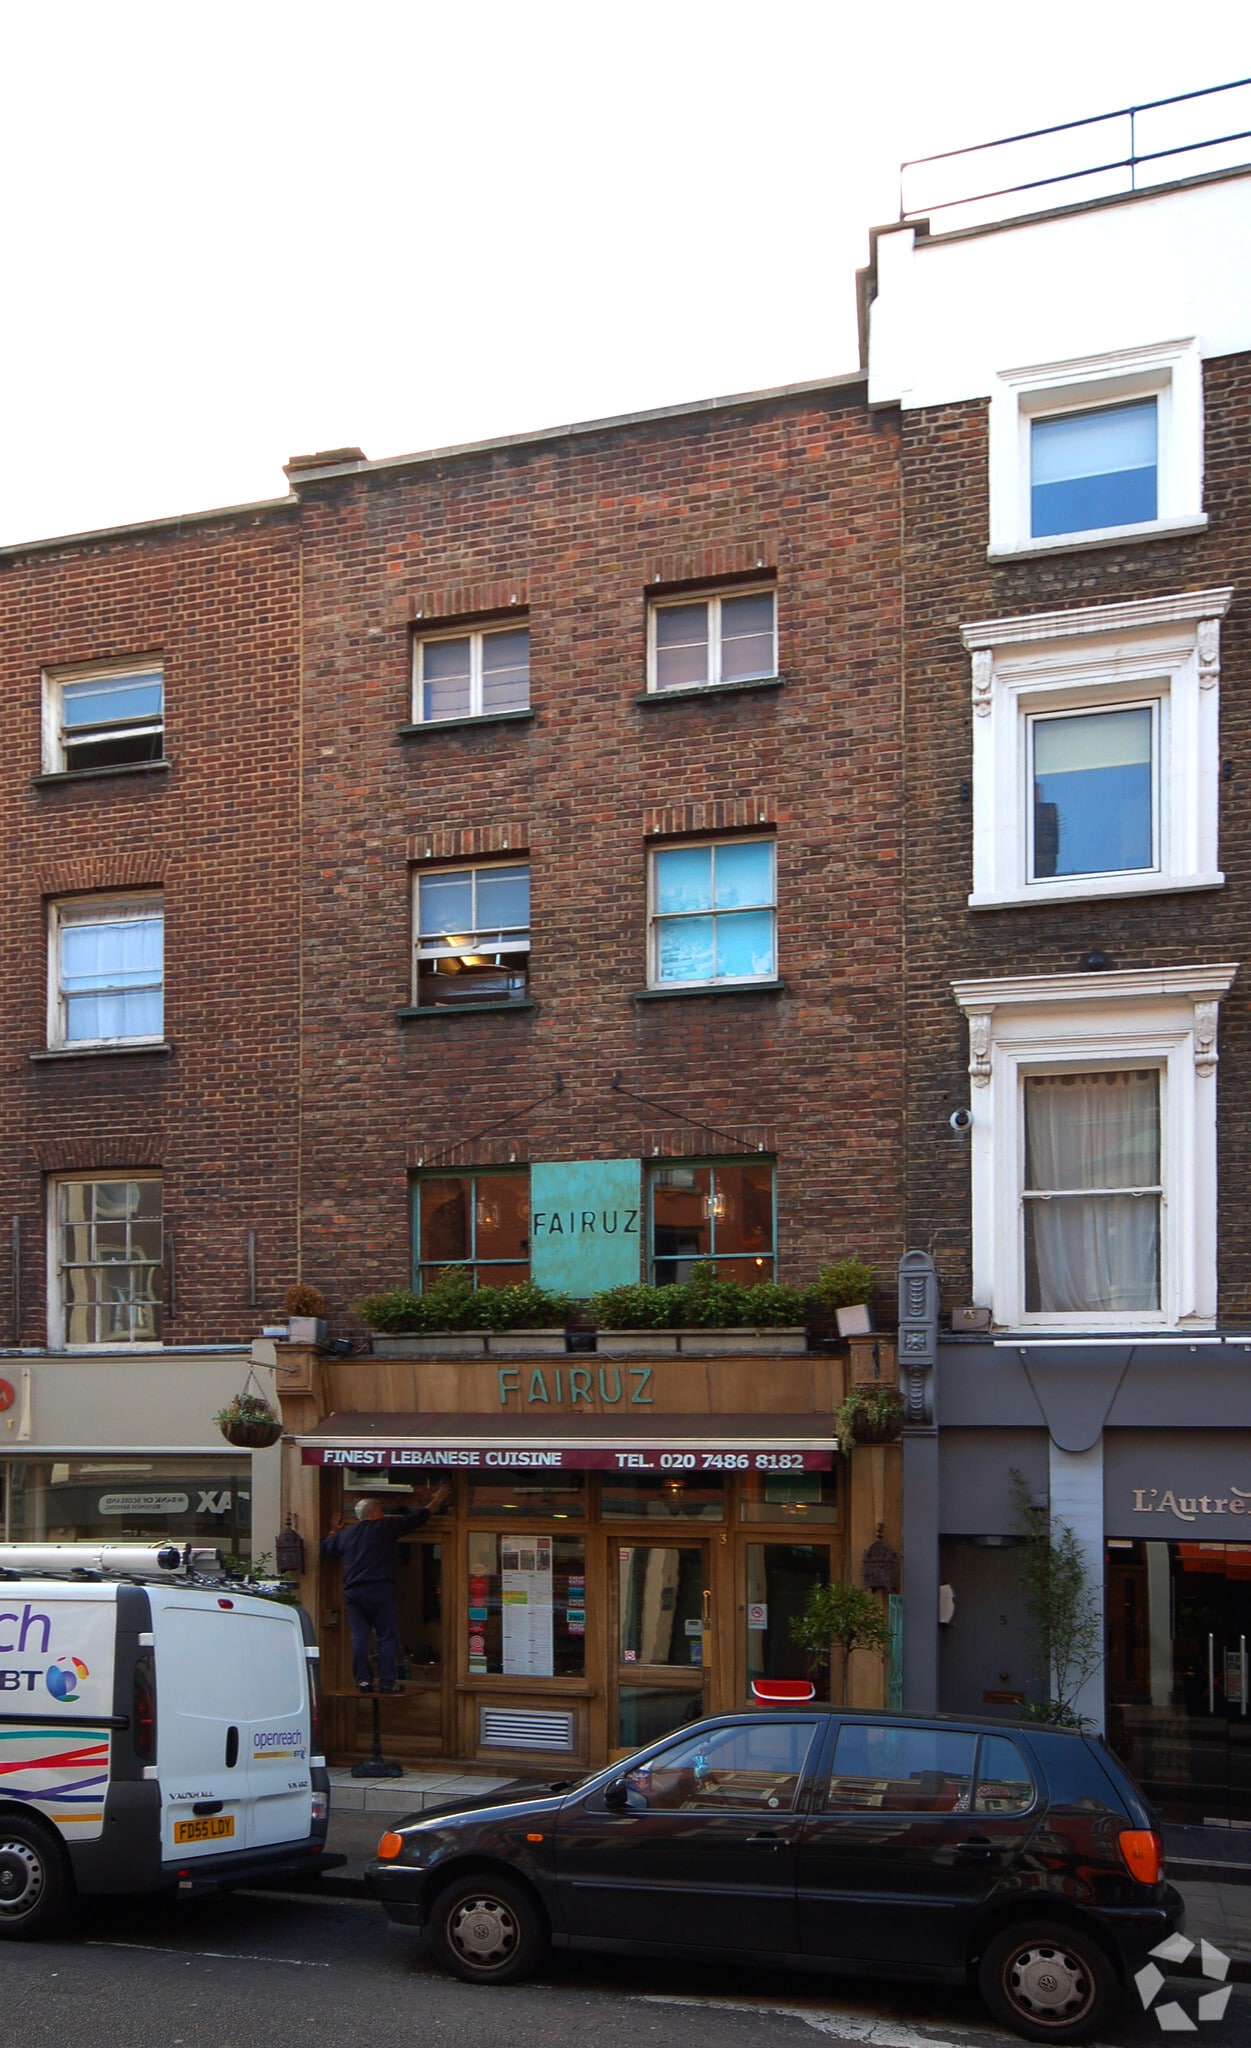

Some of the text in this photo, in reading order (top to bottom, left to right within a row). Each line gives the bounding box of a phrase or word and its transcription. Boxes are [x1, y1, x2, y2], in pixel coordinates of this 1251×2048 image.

[533, 1210, 638, 1236] FAIRUZ
[498, 1368, 653, 1404] FAIRUZ
[323, 1450, 804, 1469] FINEST LEBANESE CUISINE TEL. 020 7486 8182
[719, 1533, 728, 1544] 3
[1000, 1615, 1007, 1626] 5
[0, 1670, 43, 1691] BT
[253, 1729, 302, 1749] openreach
[179, 1818, 231, 1840] FD55 LDY
